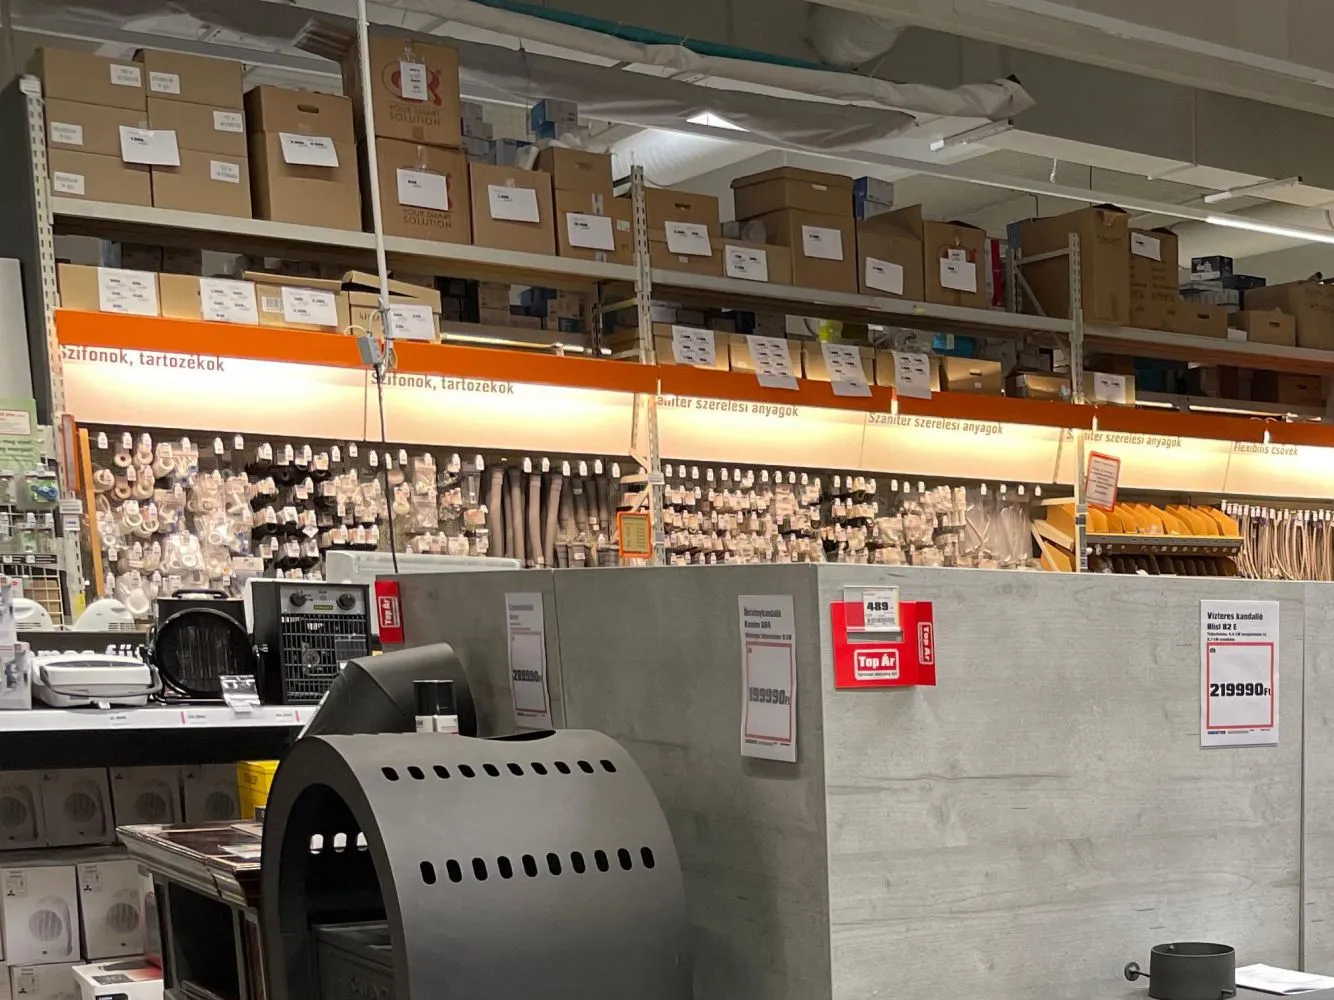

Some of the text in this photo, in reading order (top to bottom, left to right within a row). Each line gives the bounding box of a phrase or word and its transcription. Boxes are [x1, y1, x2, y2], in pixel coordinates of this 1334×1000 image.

[389, 112, 441, 126] SOLUTION
[403, 215, 452, 229] SOLUTION
[139, 352, 224, 372] tartozékok
[441, 376, 514, 395] tartozékok
[751, 403, 799, 418] anyagok
[962, 422, 1003, 437] anyagok
[1146, 436, 1182, 449] anyagok
[1233, 442, 1269, 454] Flexibilis
[867, 602, 889, 611] 489
[384, 610, 393, 626] Top
[1236, 612, 1264, 621] kandalló
[858, 653, 896, 669] Top Ár
[923, 646, 932, 662] Ár
[1210, 683, 1271, 697] 219990Ft
